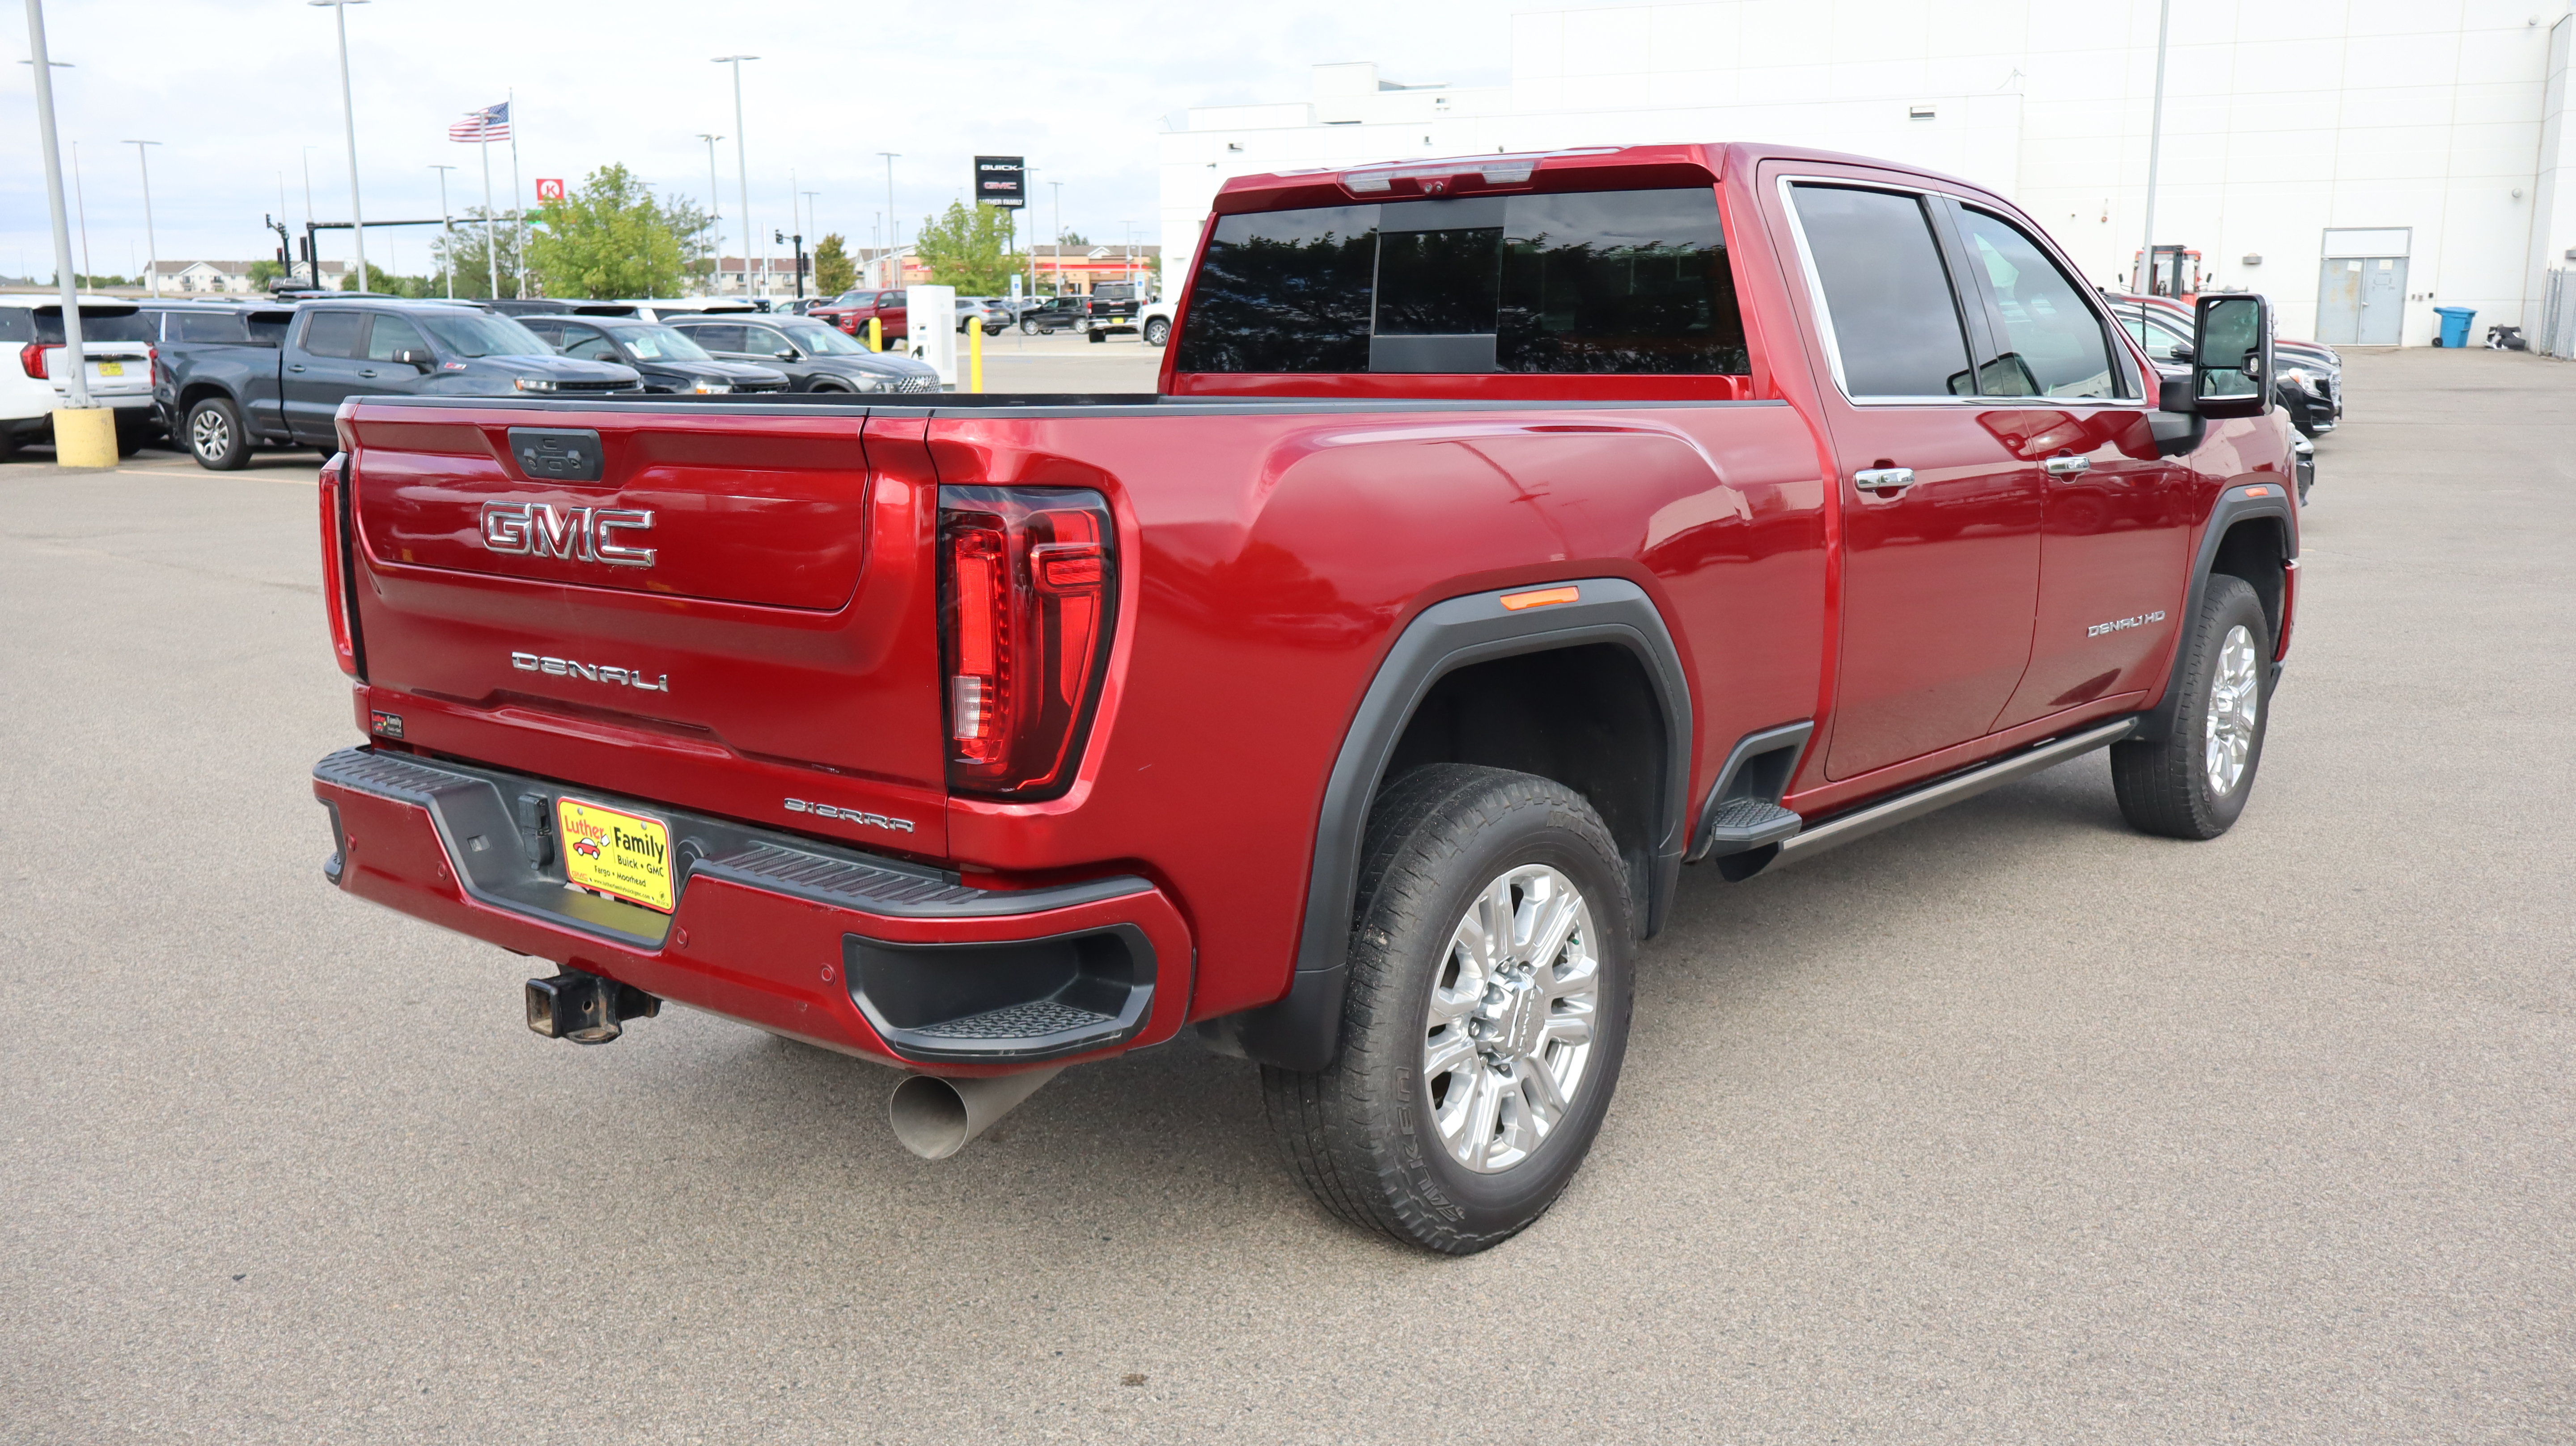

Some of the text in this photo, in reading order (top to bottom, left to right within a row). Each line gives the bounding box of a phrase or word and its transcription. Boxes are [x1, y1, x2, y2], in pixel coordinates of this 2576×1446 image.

[547, 185, 557, 197] K
[984, 181, 1017, 190] GMC
[481, 500, 656, 567] GMC
[2087, 610, 2166, 638] DENALI HD
[511, 651, 669, 693] DENALI
[784, 797, 914, 833] SIERRA
[564, 815, 664, 865] Luther Family
[572, 870, 588, 881] GMC
[594, 865, 646, 887] Fargo Moorhead
[617, 855, 664, 877] Buick GMC
